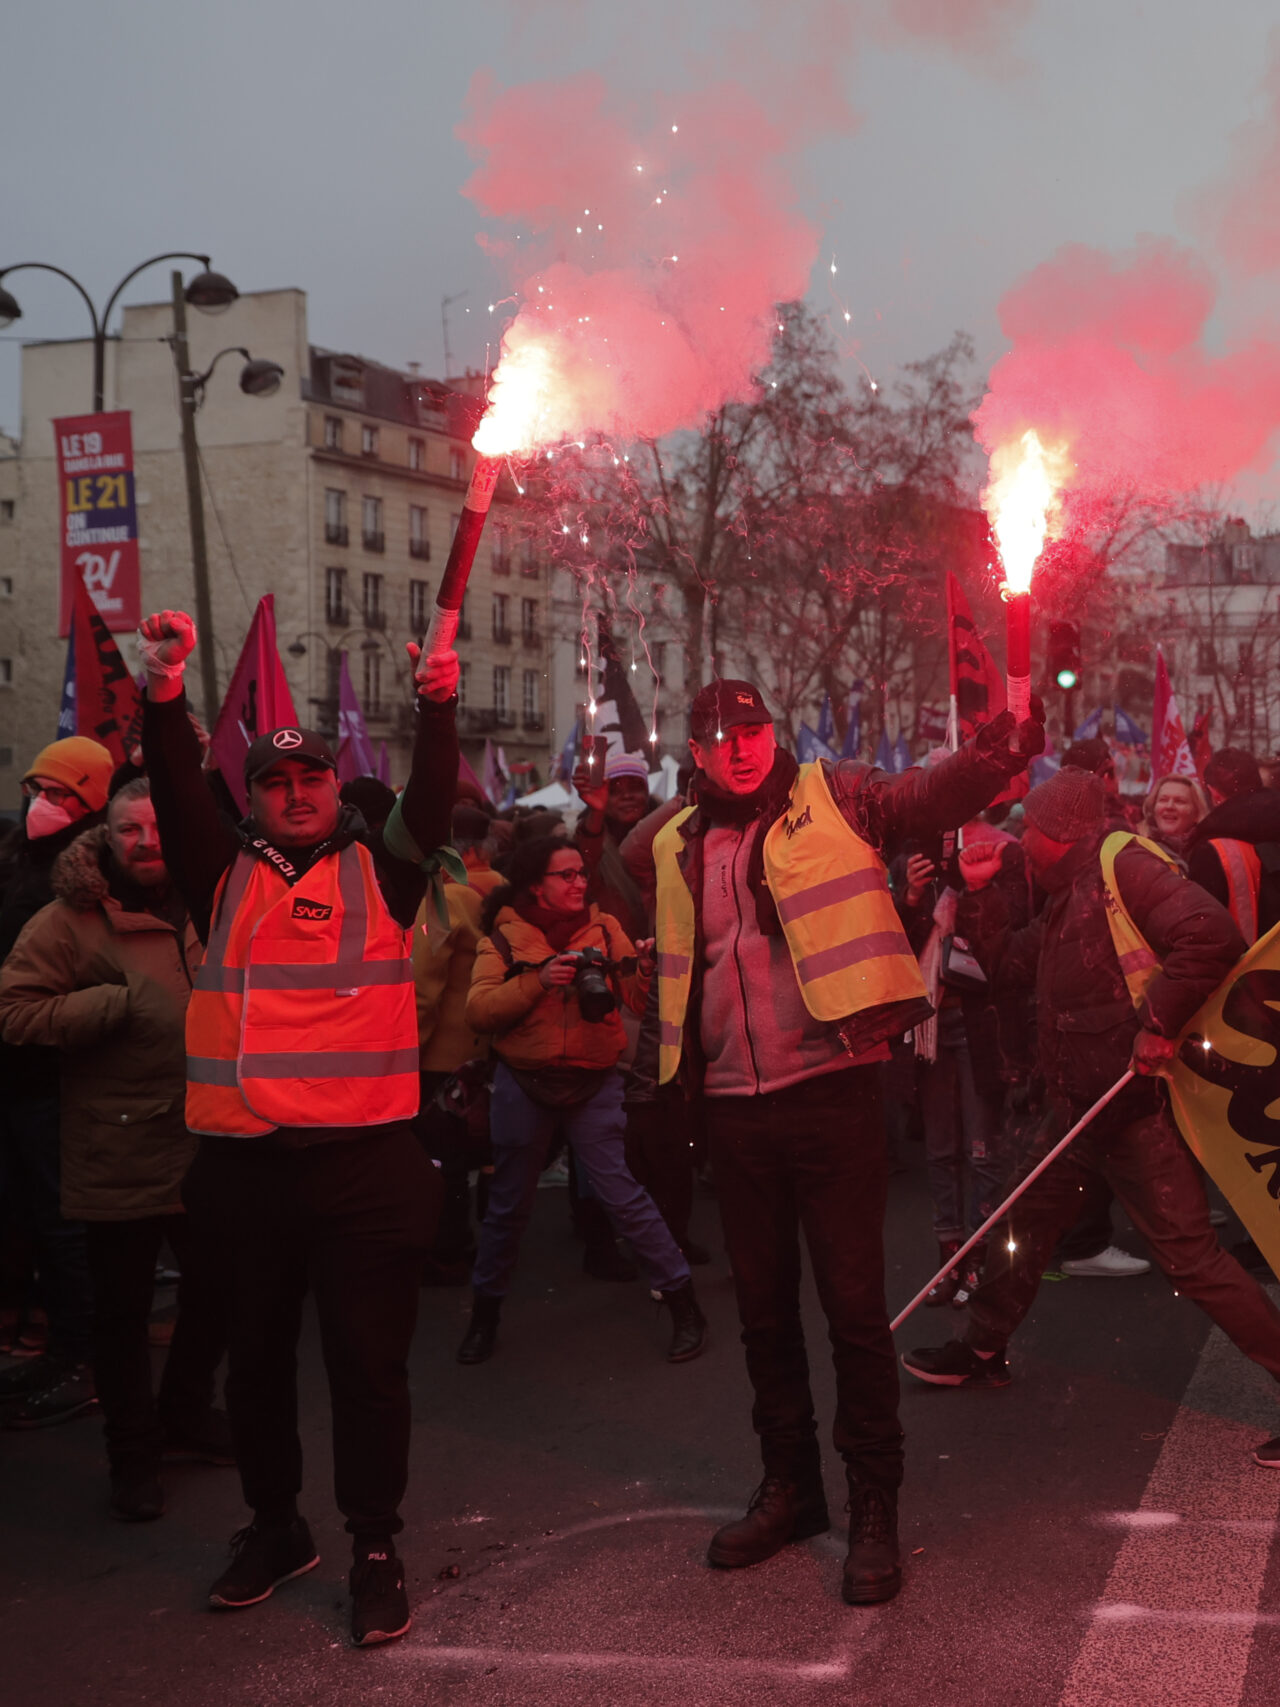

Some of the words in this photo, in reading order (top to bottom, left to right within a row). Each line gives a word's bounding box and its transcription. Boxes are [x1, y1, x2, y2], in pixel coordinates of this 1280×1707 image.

[61, 433, 82, 458] LE
[66, 477, 93, 512] LE
[95, 474, 127, 509] 21
[66, 512, 87, 530] ON
[65, 525, 130, 547] CONTINUE
[262, 846, 296, 877] ICON
[293, 905, 332, 919] SNCF
[367, 1552, 388, 1561] FILA
